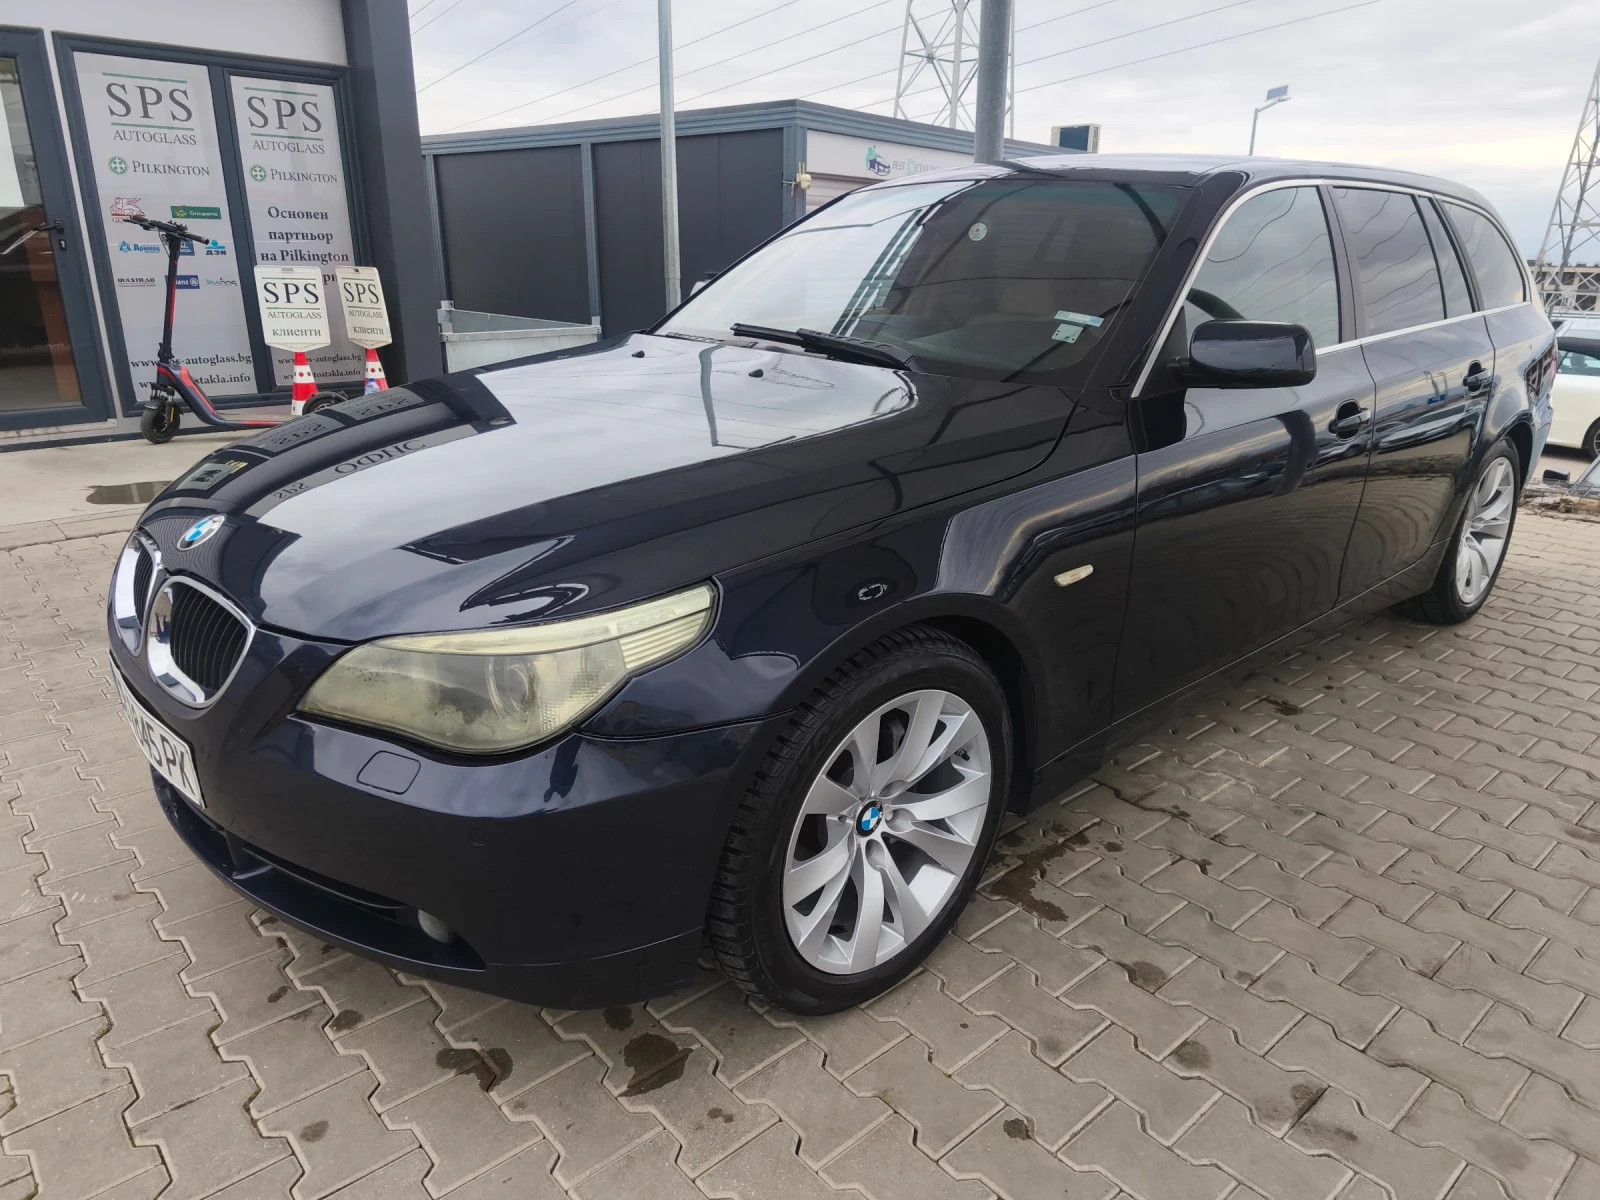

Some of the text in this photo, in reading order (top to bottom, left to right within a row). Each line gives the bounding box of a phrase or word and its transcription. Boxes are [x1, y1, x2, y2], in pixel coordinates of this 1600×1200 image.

[106, 82, 193, 122] SPS
[247, 96, 322, 132] SPS
[113, 130, 197, 145] AUTOGLASS
[252, 140, 325, 154] AUTOGLASS
[132, 160, 210, 176] PILKINGTON
[892, 160, 906, 171] BEST
[270, 168, 338, 183] PILKINGTON
[267, 206, 329, 220] Основен
[268, 231, 334, 244] партньор
[260, 249, 349, 265] на Pilkington
[263, 282, 319, 304] SPS
[343, 282, 380, 304] SPS
[267, 311, 322, 319] AUTOGLASS
[348, 309, 383, 319] AUTOGLASS
